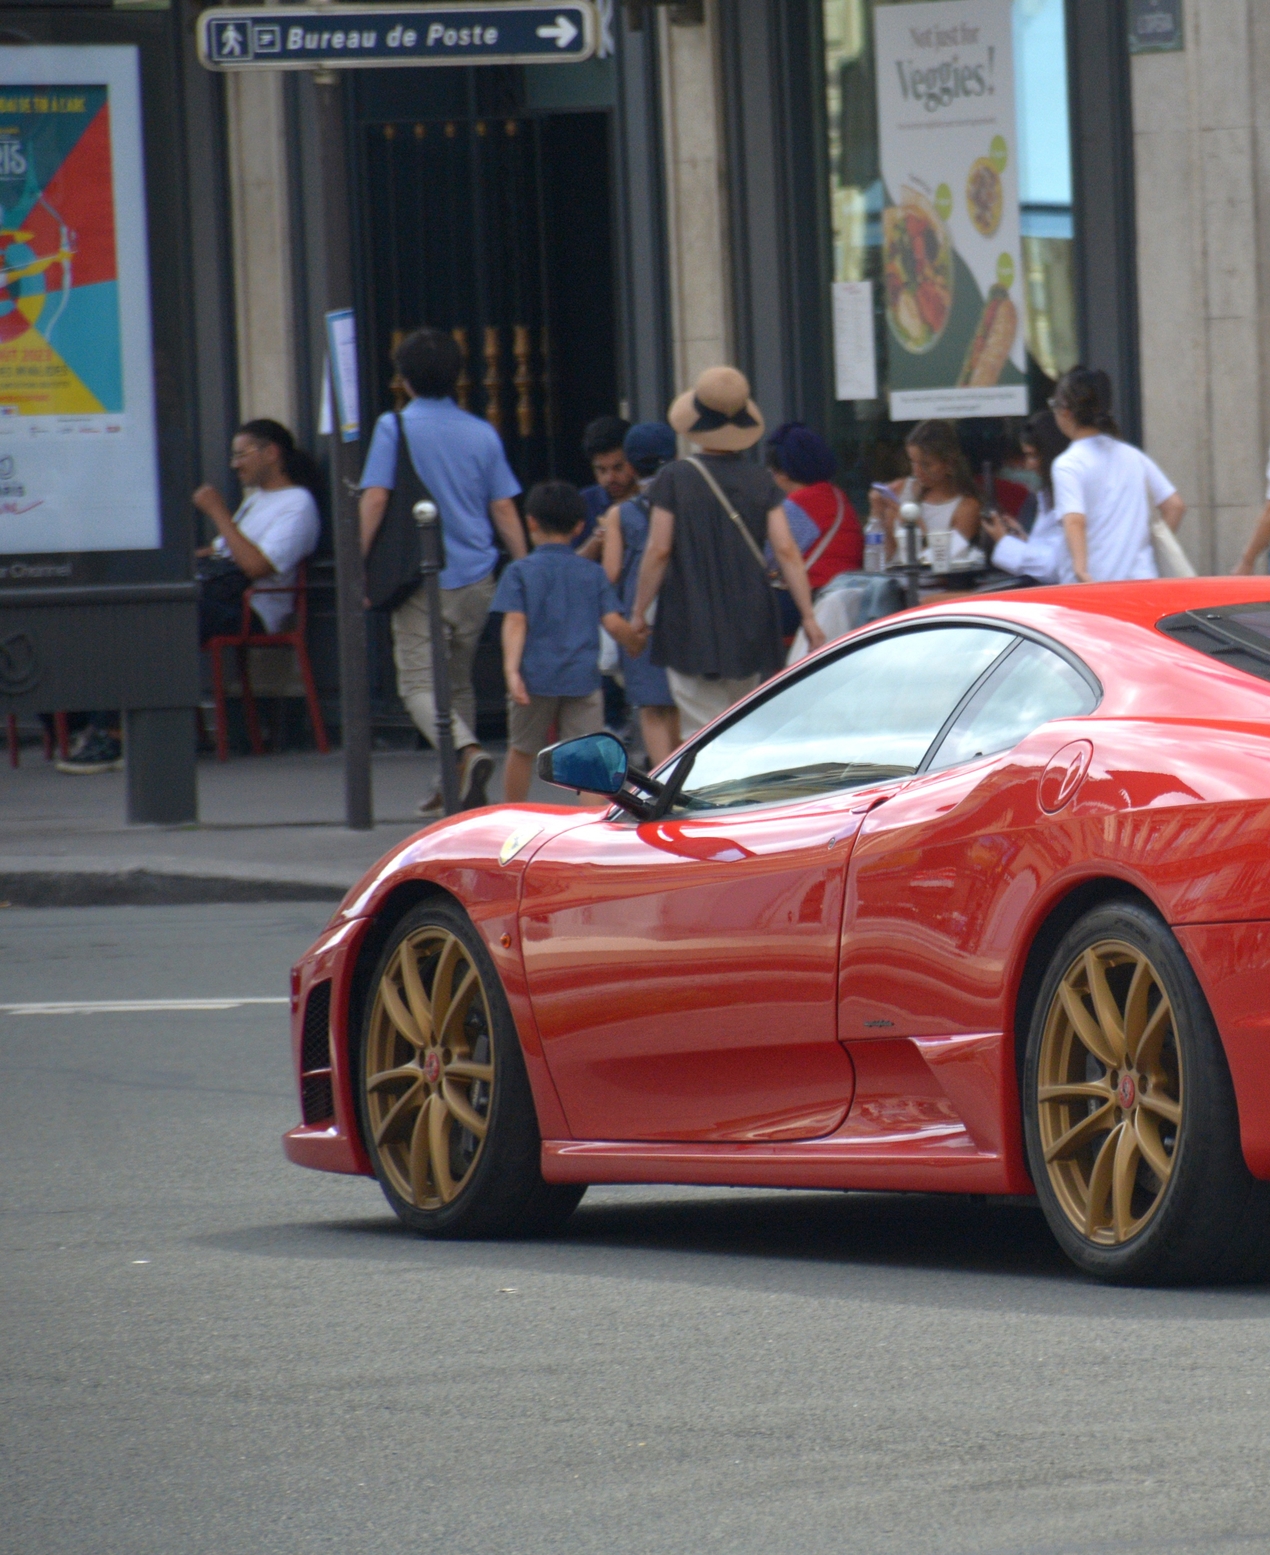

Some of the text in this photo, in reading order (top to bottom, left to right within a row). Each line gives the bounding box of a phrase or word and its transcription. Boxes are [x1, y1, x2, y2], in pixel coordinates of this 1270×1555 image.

[286, 22, 499, 50] Bureau de Poste
[894, 45, 996, 113] Veggies!
